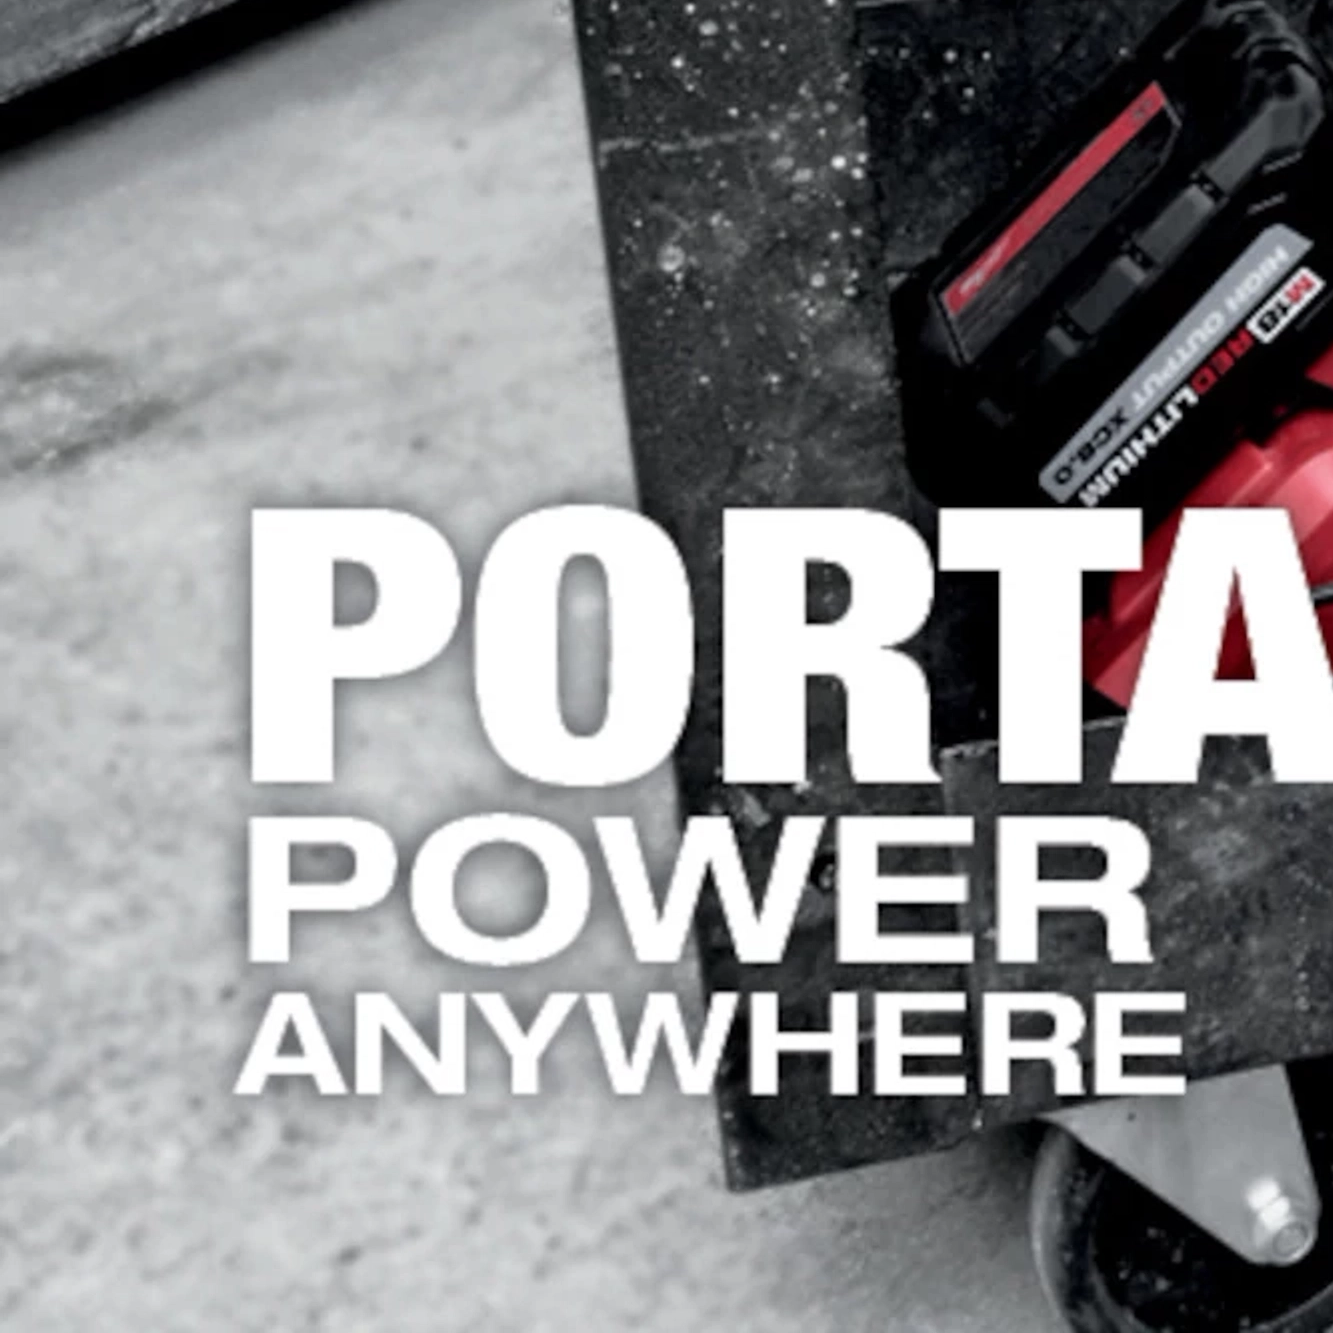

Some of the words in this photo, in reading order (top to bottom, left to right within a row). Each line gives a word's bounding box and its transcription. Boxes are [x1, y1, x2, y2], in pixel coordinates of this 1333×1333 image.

[1223, 244, 1290, 314] HIGH
[1257, 276, 1316, 334] M18
[1130, 311, 1226, 410] OUTPUT
